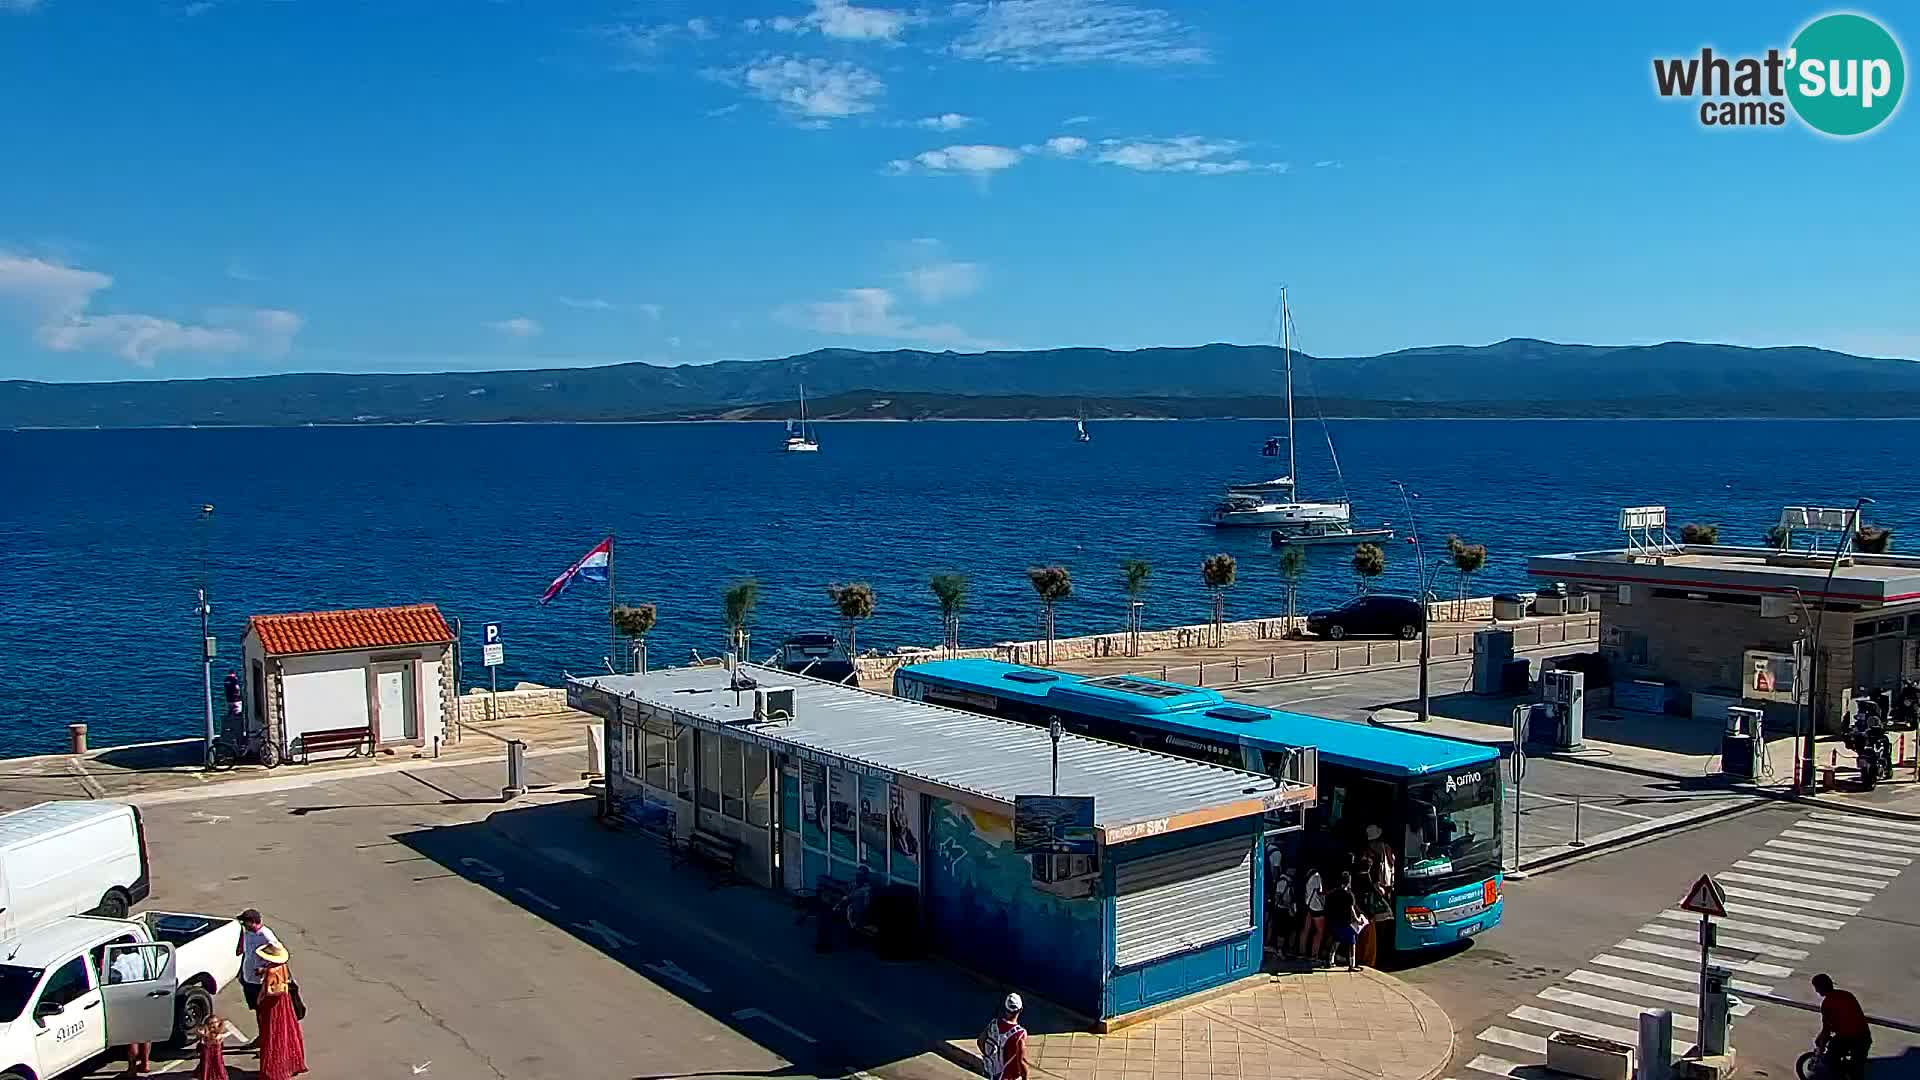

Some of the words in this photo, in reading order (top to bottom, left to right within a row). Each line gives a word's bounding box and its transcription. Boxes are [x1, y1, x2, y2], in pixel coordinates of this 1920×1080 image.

[487, 625, 497, 642] P
[811, 750, 841, 768] STATION
[844, 761, 867, 777] TICKET
